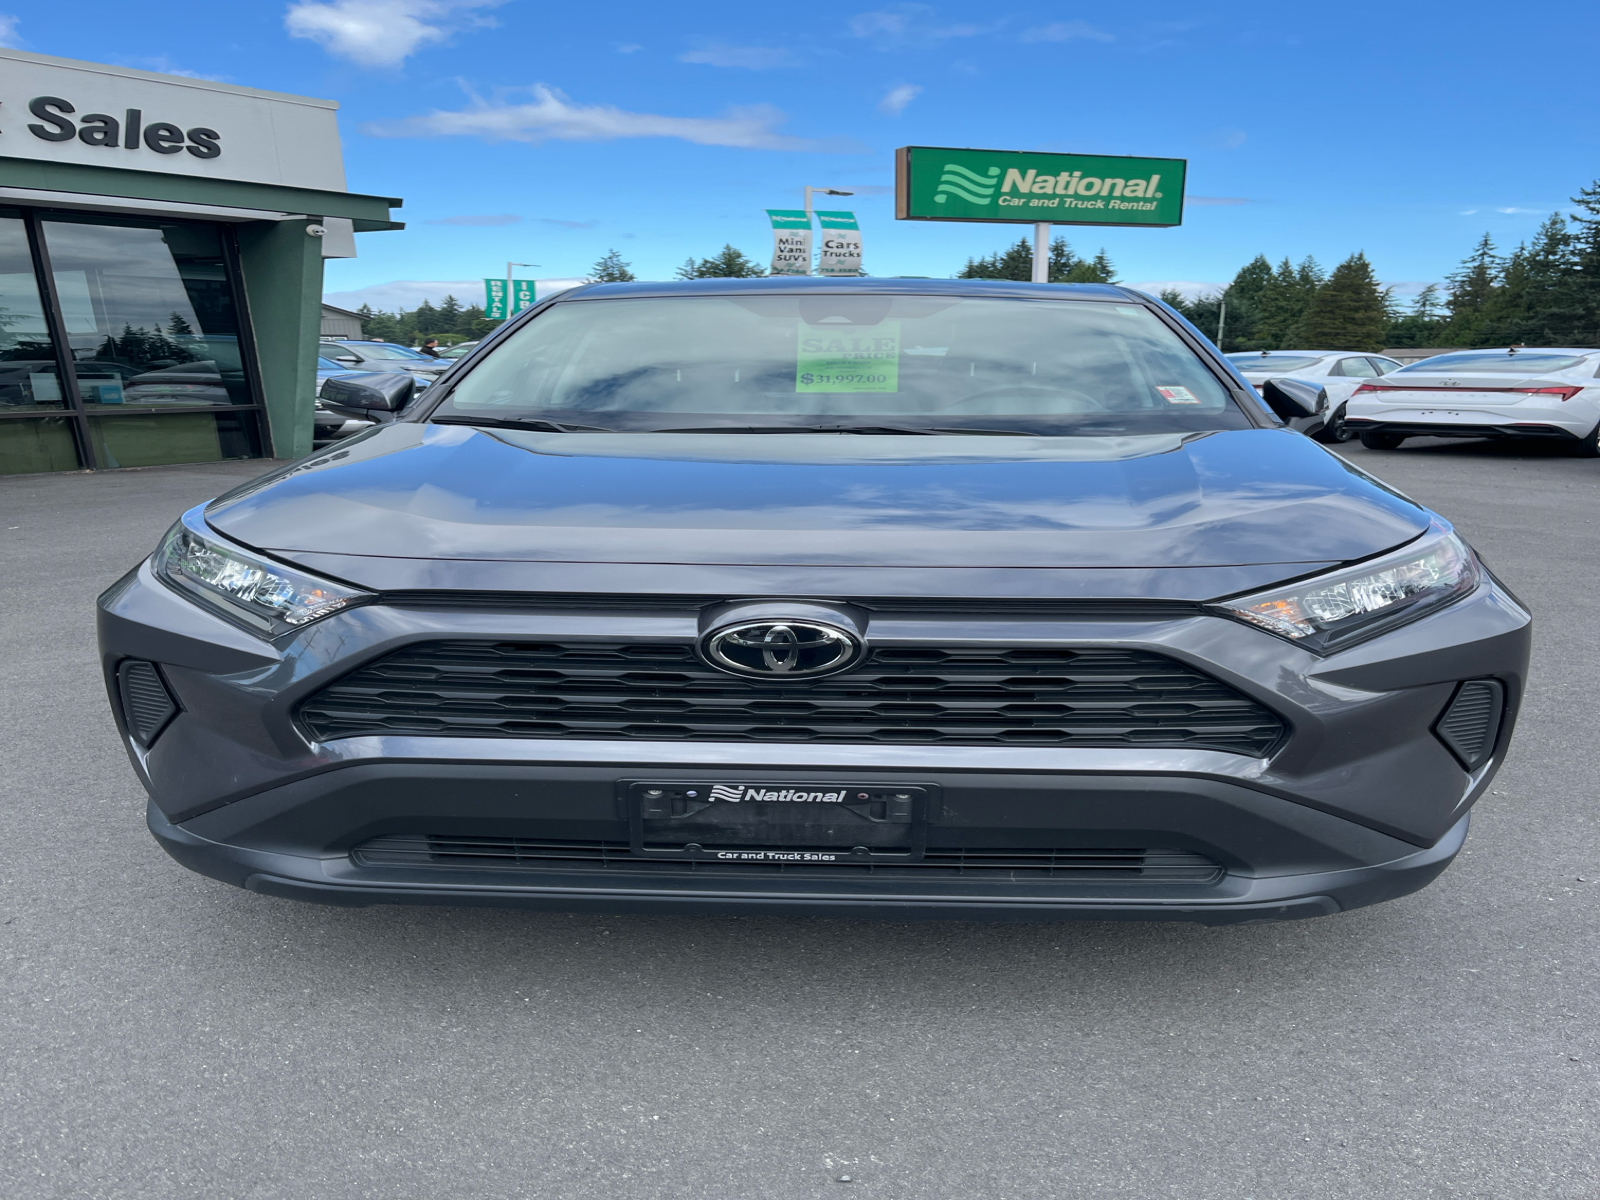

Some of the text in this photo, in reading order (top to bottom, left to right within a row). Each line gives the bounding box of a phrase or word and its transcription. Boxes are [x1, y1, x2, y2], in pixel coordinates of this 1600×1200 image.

[27, 95, 222, 159] Sales
[1000, 168, 1162, 199] National
[998, 195, 1158, 211] Car and Truck Rental
[778, 237, 806, 246] Mini
[824, 240, 860, 249] Cars
[778, 246, 806, 254] Vans
[822, 250, 861, 258] Trucks
[776, 254, 807, 262] SUV's
[489, 280, 503, 318] RENTALS
[518, 281, 531, 310] ICB
[801, 337, 896, 353] SALE
[842, 352, 896, 360] PRICE
[800, 371, 887, 386] $31,997.00
[744, 788, 847, 802] National
[741, 852, 764, 860] and
[767, 852, 801, 860] Truck
[804, 853, 836, 861] Sales
